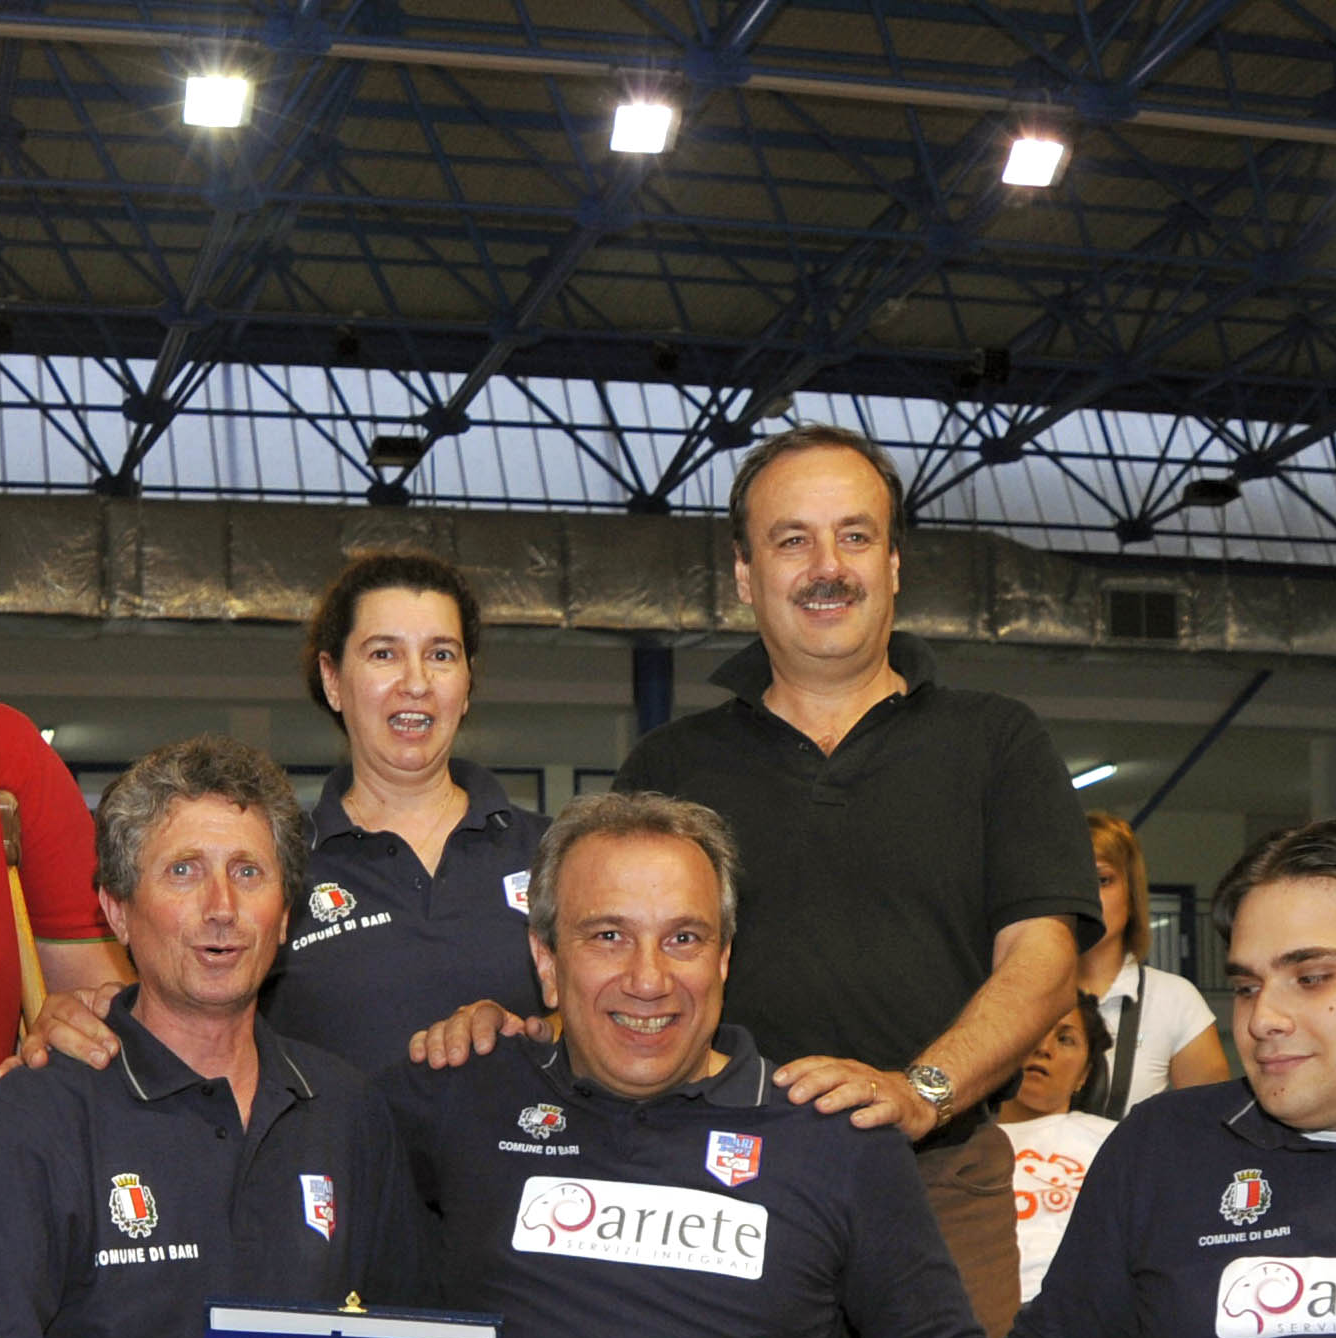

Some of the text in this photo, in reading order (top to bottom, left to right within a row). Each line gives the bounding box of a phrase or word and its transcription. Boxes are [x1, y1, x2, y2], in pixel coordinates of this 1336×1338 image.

[292, 912, 392, 950] COMUNE DI BARI
[498, 1140, 580, 1155] COMUNE DI BARI
[1198, 1226, 1292, 1247] COMUNE DI BARI
[150, 1246, 165, 1261] DI
[169, 1244, 199, 1259] BARI
[567, 1239, 759, 1273] SERVIZI INTEGRATI
